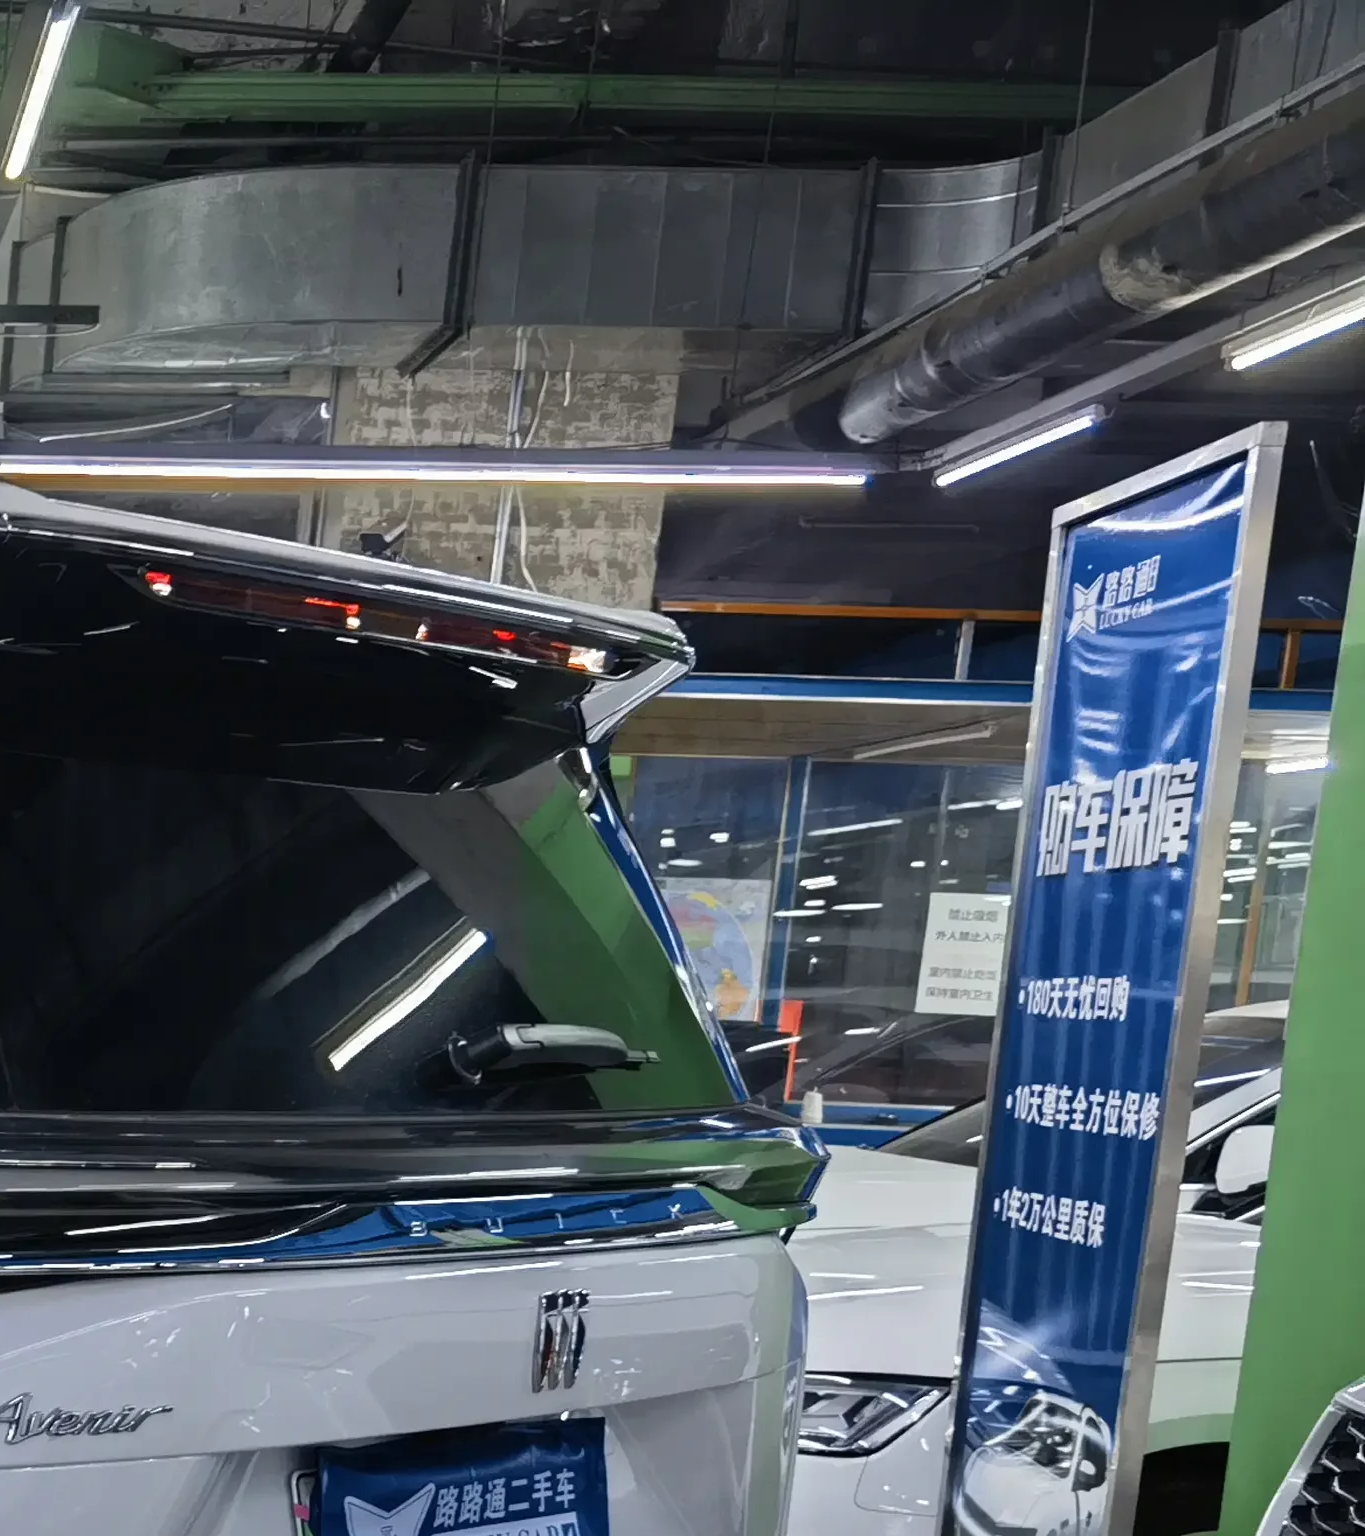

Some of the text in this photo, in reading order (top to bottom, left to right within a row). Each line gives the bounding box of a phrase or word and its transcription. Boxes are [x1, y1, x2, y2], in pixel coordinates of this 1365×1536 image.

[1036, 758, 1199, 877] 购车保障
[434, 1468, 576, 1528] 路路通二手车
